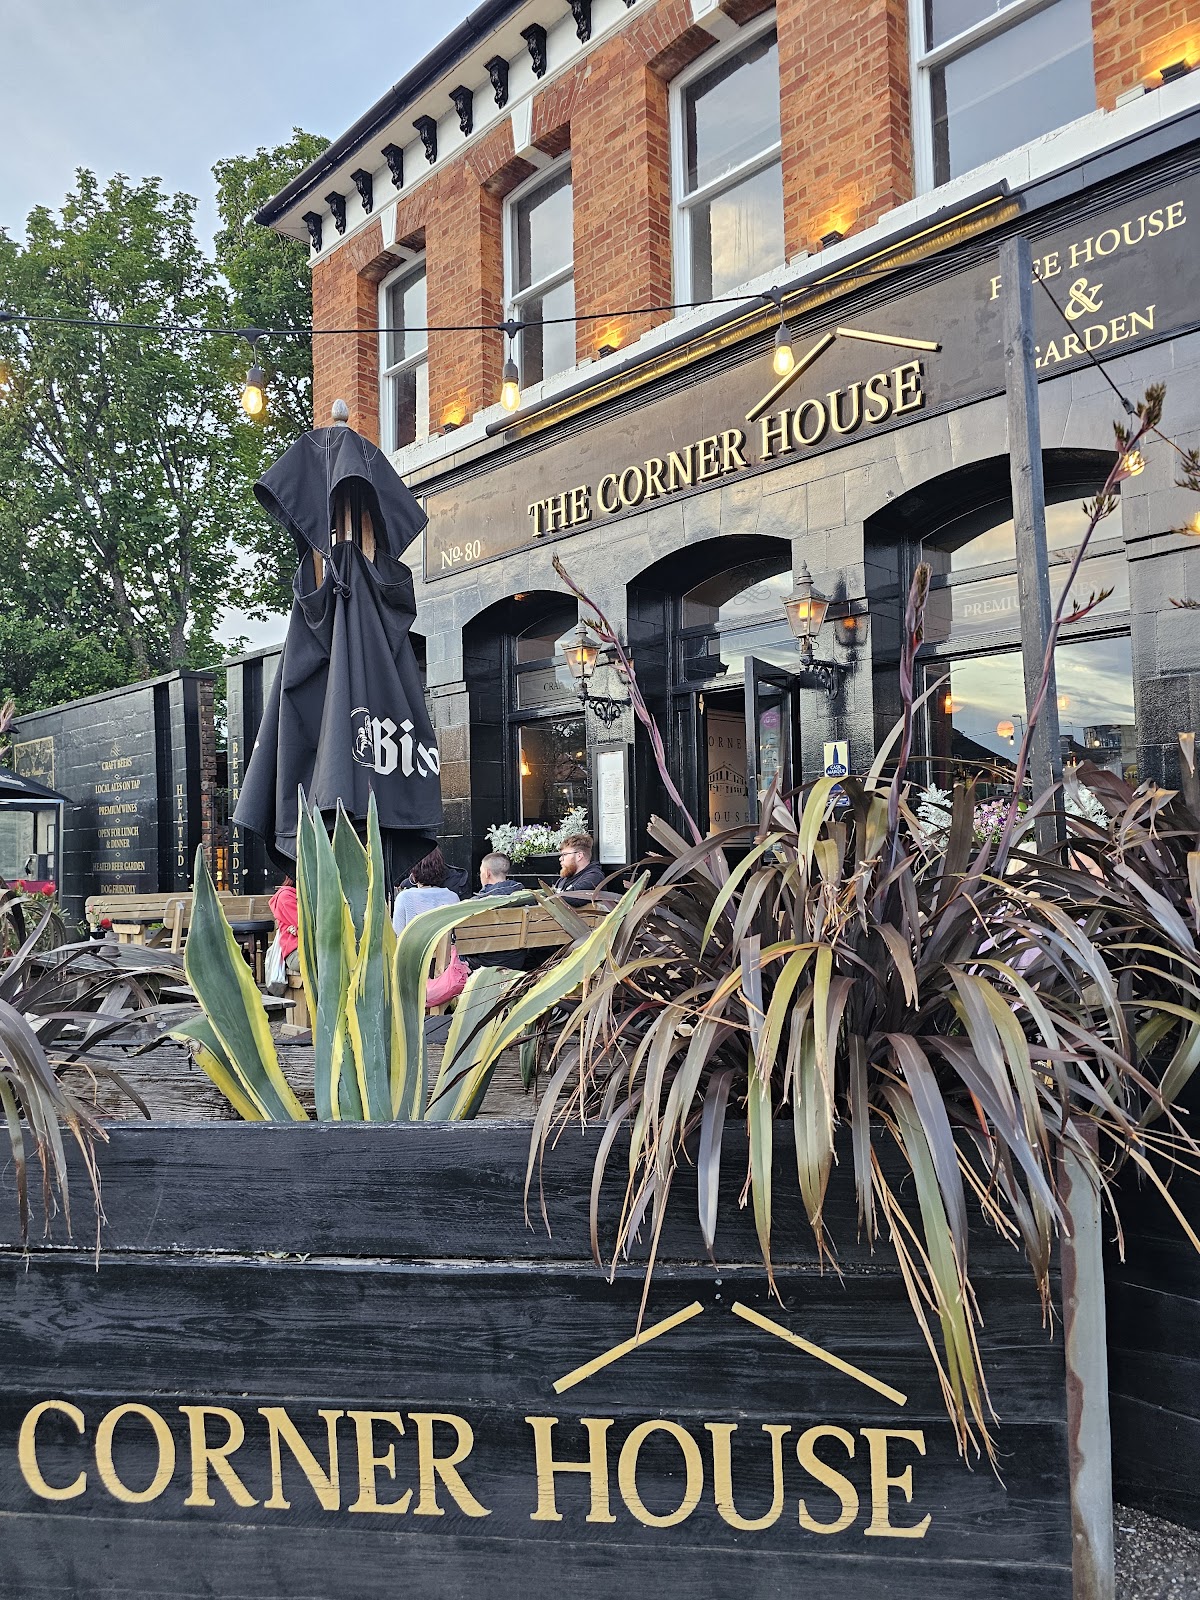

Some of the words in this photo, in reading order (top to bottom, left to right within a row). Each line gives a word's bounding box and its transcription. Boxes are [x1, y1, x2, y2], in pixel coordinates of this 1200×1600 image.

[989, 251, 1062, 301] FEE
[1068, 200, 1187, 269] HOUSE
[1064, 277, 1104, 321] &
[527, 484, 592, 538] THE
[596, 428, 748, 514] CORNER
[758, 359, 924, 460] HOUSE
[464, 539, 481, 562] 80
[101, 759, 117, 771] CRAFT
[117, 757, 132, 769] BEERS
[95, 783, 111, 794] LOCAL
[111, 781, 122, 792] ALES
[122, 780, 131, 791] ON
[131, 779, 140, 790] TAP
[98, 804, 121, 816] PREMIUM
[120, 803, 138, 813] WINES
[98, 828, 111, 839] OPEN
[111, 828, 122, 837] FOR
[121, 826, 139, 837] LUNCH
[176, 783, 185, 867] HEATED
[106, 840, 111, 849] &
[111, 838, 130, 849] DINNER
[92, 862, 112, 872] HEATED
[111, 861, 124, 871] BEER
[124, 860, 146, 871] GARDEN
[232, 826, 240, 897] ARDEN
[101, 884, 112, 894] DOG
[112, 884, 136, 894] FRIENDLY
[18, 1399, 493, 1518] CORNER
[524, 1416, 932, 1539] HOUSE
